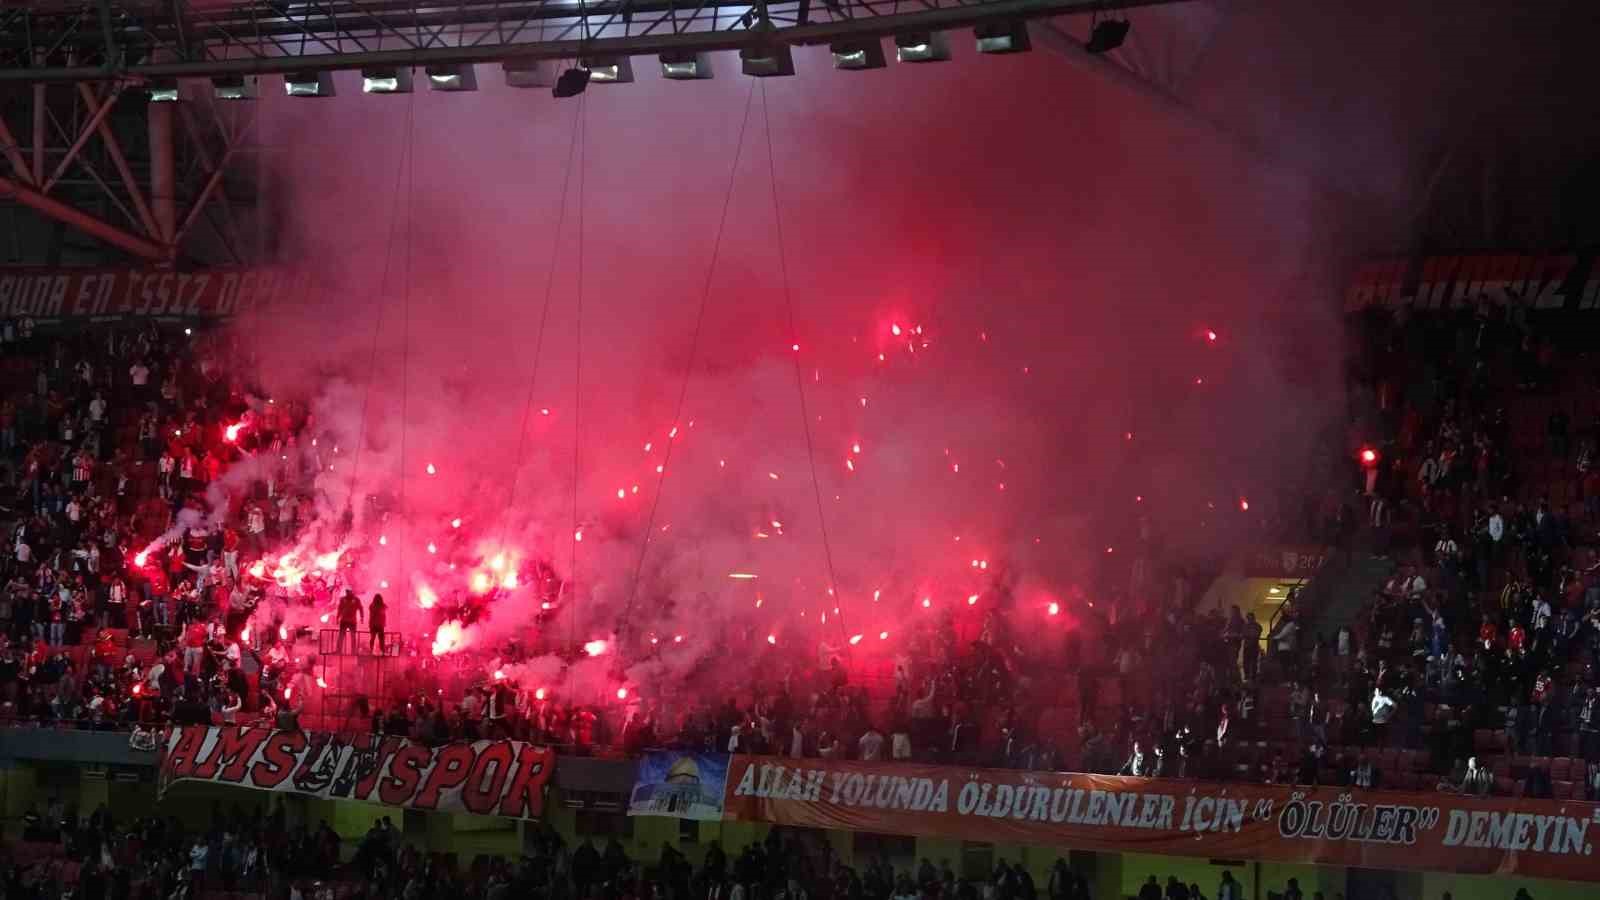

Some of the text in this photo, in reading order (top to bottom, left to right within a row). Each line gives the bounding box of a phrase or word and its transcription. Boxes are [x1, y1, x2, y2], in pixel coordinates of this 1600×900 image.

[73, 272, 116, 315] EN
[734, 763, 826, 801] ALLAH
[830, 770, 949, 813] YOLUNDA
[957, 773, 1175, 831] ÖLDÜRÜLENLER
[1179, 788, 1248, 841] İÇİN
[1442, 807, 1593, 855] DEMEYİN.
